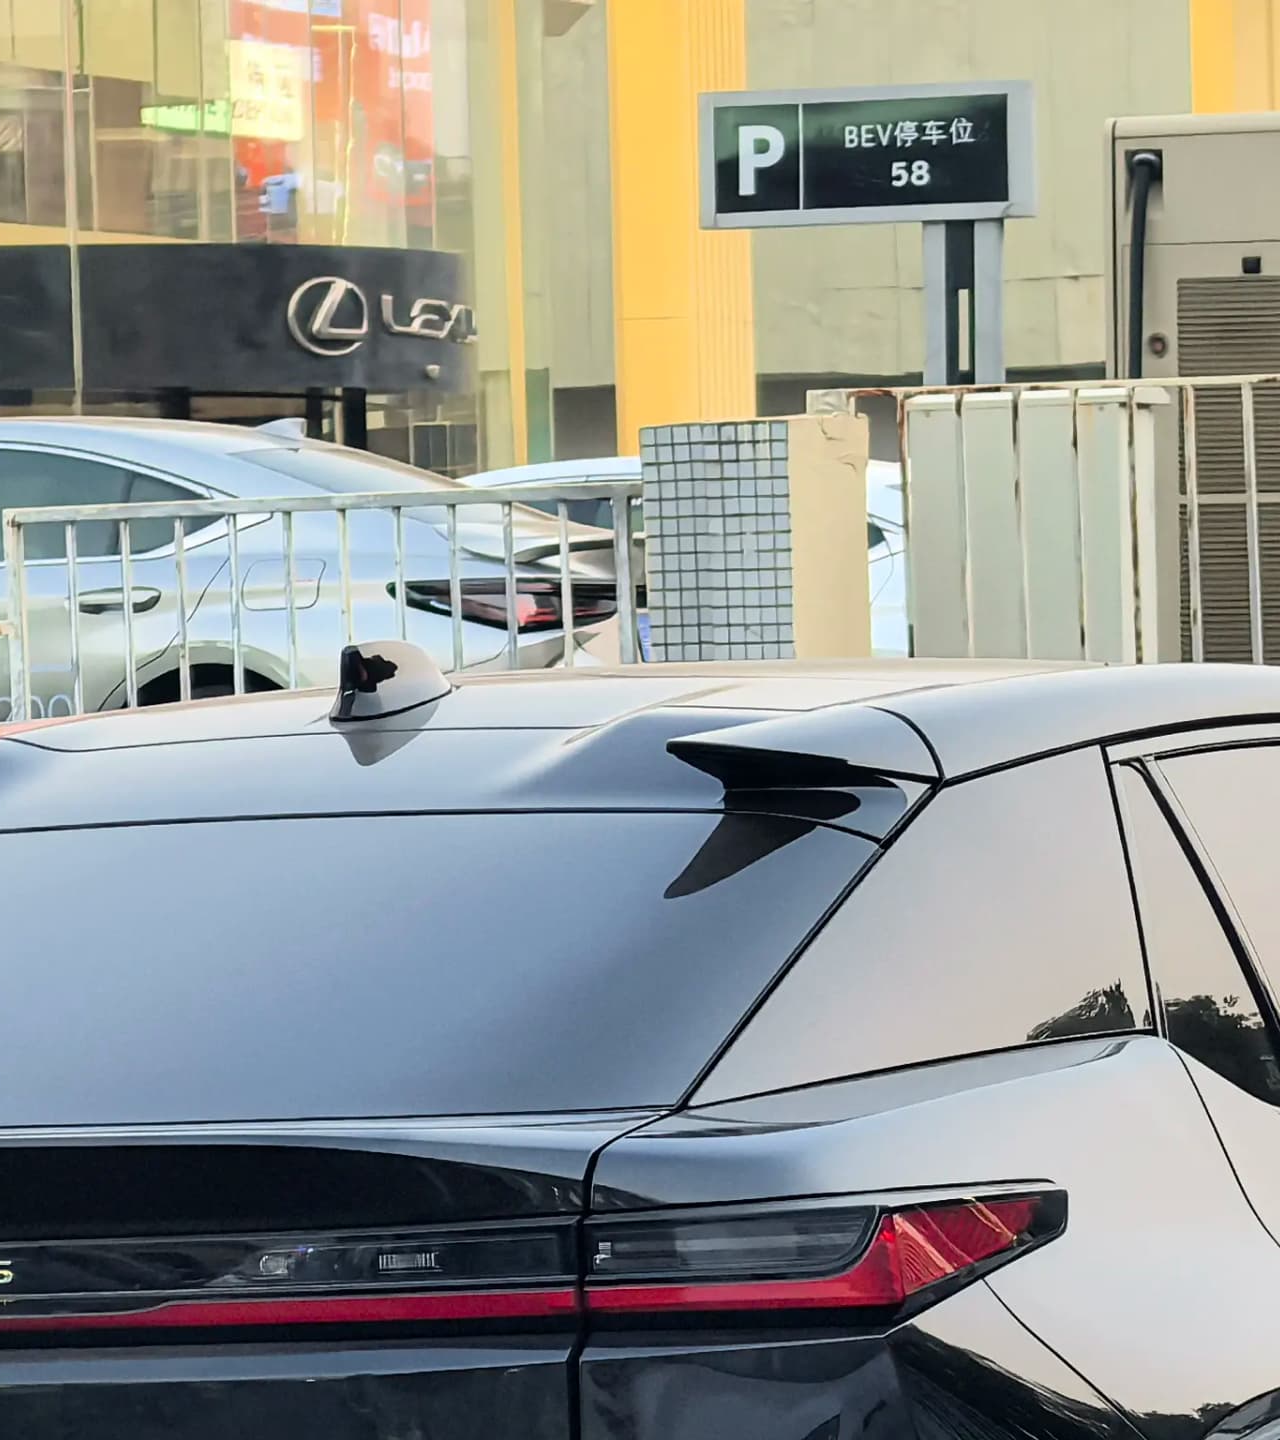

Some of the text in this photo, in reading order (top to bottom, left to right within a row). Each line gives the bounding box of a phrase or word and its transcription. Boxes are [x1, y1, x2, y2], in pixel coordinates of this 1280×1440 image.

[844, 117, 977, 149] BEV停车位
[738, 125, 785, 196] P
[891, 160, 931, 188] 58
